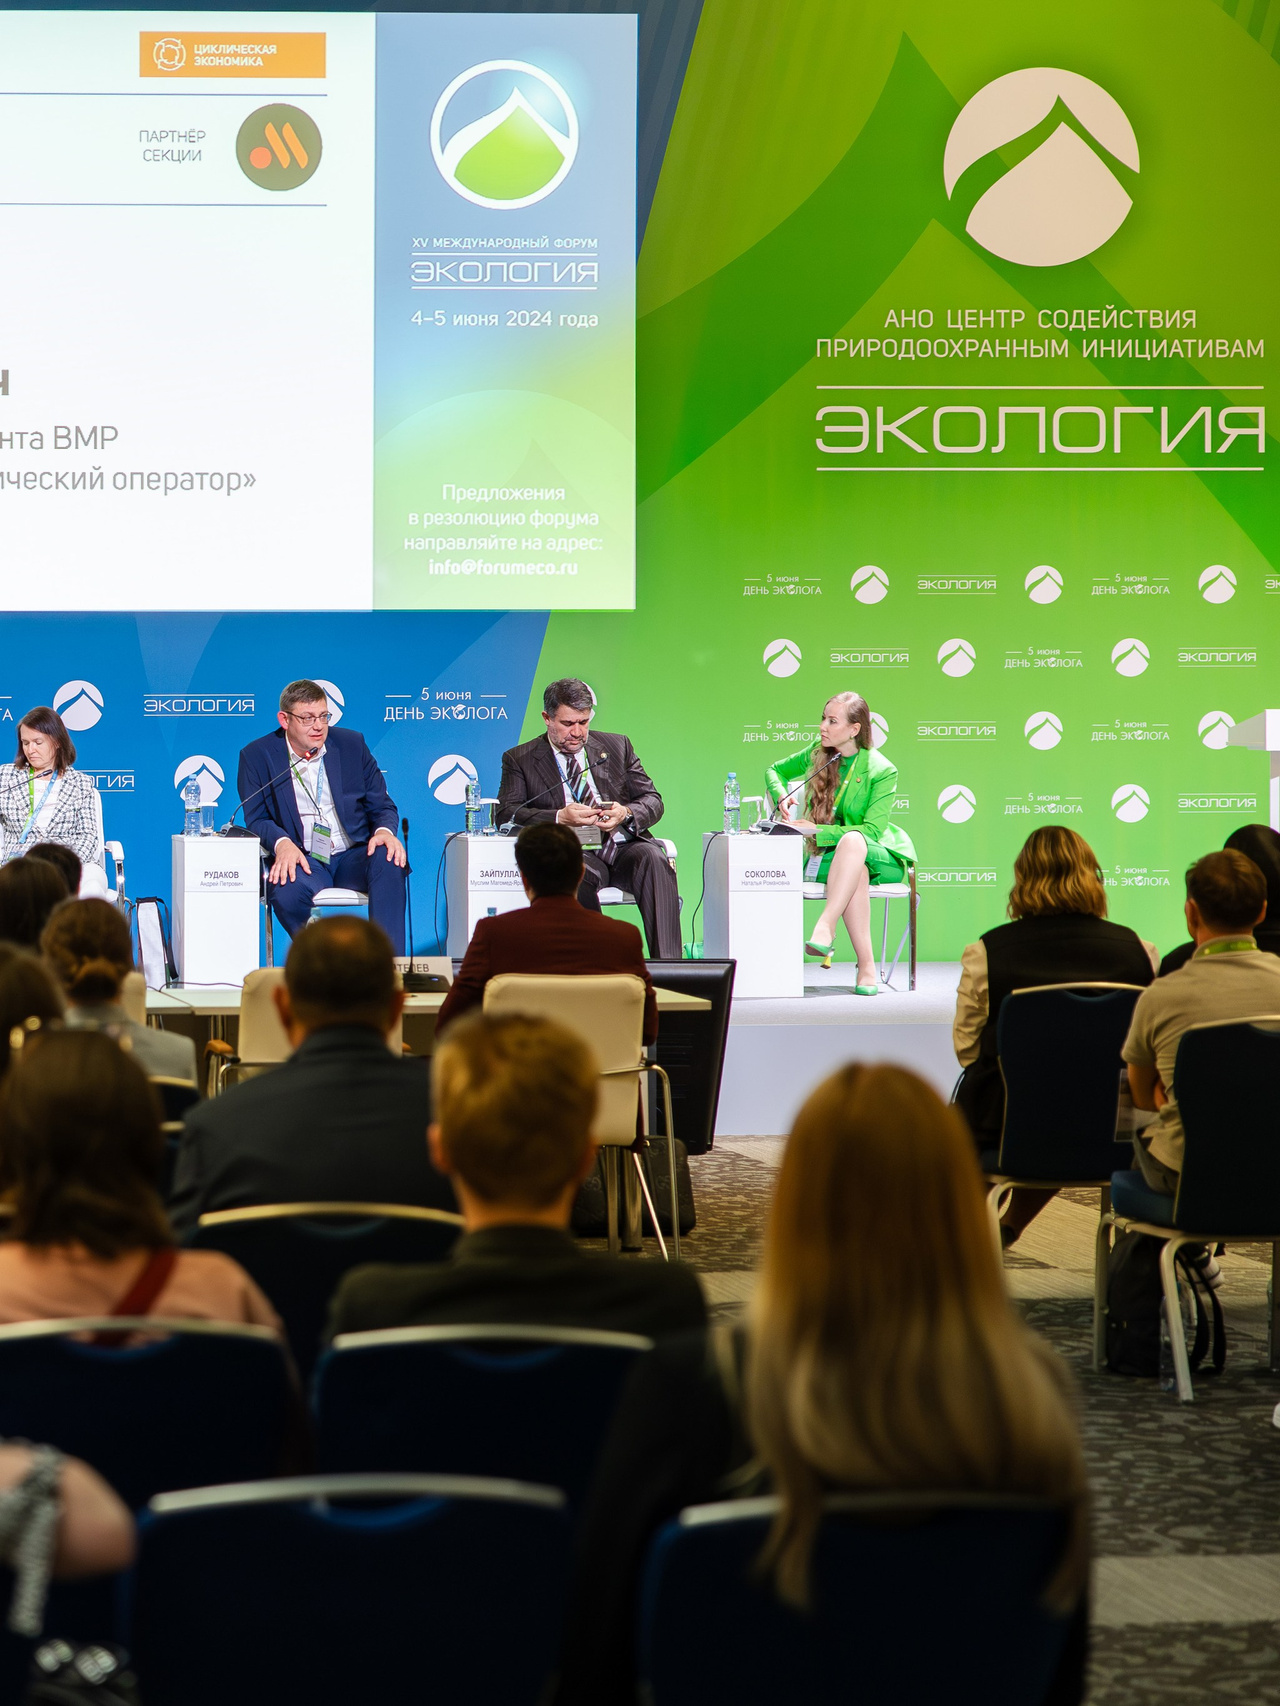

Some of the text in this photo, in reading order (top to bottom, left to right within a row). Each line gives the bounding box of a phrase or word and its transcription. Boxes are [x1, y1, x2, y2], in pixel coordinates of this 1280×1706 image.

[194, 45, 276, 55] ЦИКЛИЧЕСКАЯ
[194, 56, 263, 66] ЭКОНОМИКА
[140, 129, 206, 143] ПАРТНЁР
[143, 149, 201, 163] СЕКЦИИ
[413, 236, 597, 249] XV МЕЖДУНАРОДНЫЙ ФОРУМ
[409, 260, 598, 283] ЭКОЛОГИЯ
[453, 315, 498, 325] июня
[507, 311, 552, 326] 2024
[560, 315, 598, 328] года
[885, 304, 1197, 331] АНО ЦЕНТР СОДЕЙСТВИЯ
[817, 339, 1265, 361] ПРИРОДООХРАННЫМ ИНИЦИАТИВАМ
[816, 406, 1265, 453] ЭКОЛОГИЯ
[55, 426, 118, 449] ВМР
[113, 472, 256, 496] оператор»
[443, 484, 565, 503] Предложения
[409, 510, 599, 529] в резолюцию форума
[405, 535, 602, 553] направляйте на адрес:
[428, 559, 578, 575] info@forumeco.ru
[767, 574, 772, 582] 5
[1115, 574, 1120, 582] 5
[743, 585, 822, 595] ДЕНЬ ЭКОЛОГА
[918, 580, 996, 589] ЭКОЛОГИЯ
[1092, 584, 1170, 595] ДЕНЬ ЭКОЛОГА
[1028, 647, 1033, 655] 5
[831, 653, 909, 663] ЭКОЛОГИЯ
[1004, 657, 1082, 668] ДЕНЬ ЭКОЛОГА
[1178, 653, 1256, 662] ЭКОЛОГИЯ
[421, 688, 471, 700] 5 июня
[144, 700, 254, 711] ЭКОЛОГИЯ
[384, 704, 508, 721] ДЕНЬ ЭКОЛОГА
[767, 721, 772, 729] 5
[1115, 720, 1120, 728] 5
[918, 726, 996, 735] ЭКОЛОГИЯ
[1091, 730, 1169, 741] ДЕНЬ ЭКОЛОГА
[743, 733, 769, 742] ДЕНЬ
[1028, 793, 1033, 801] 5
[1005, 803, 1083, 814] ДЕНЬ ЭКОЛОГА
[1178, 798, 1256, 808] ЭКОЛОГИЯ
[204, 871, 239, 879] РУДАКОВ
[480, 869, 521, 877] ЗАЙПУЛЛА
[745, 870, 786, 878] СОКОЛОВА
[1115, 865, 1120, 874] 5
[918, 872, 996, 881] ЭКОЛОГИЯ
[1121, 875, 1170, 887] ЭКОЛОГА
[392, 963, 430, 972] ТЕЛЕВ
